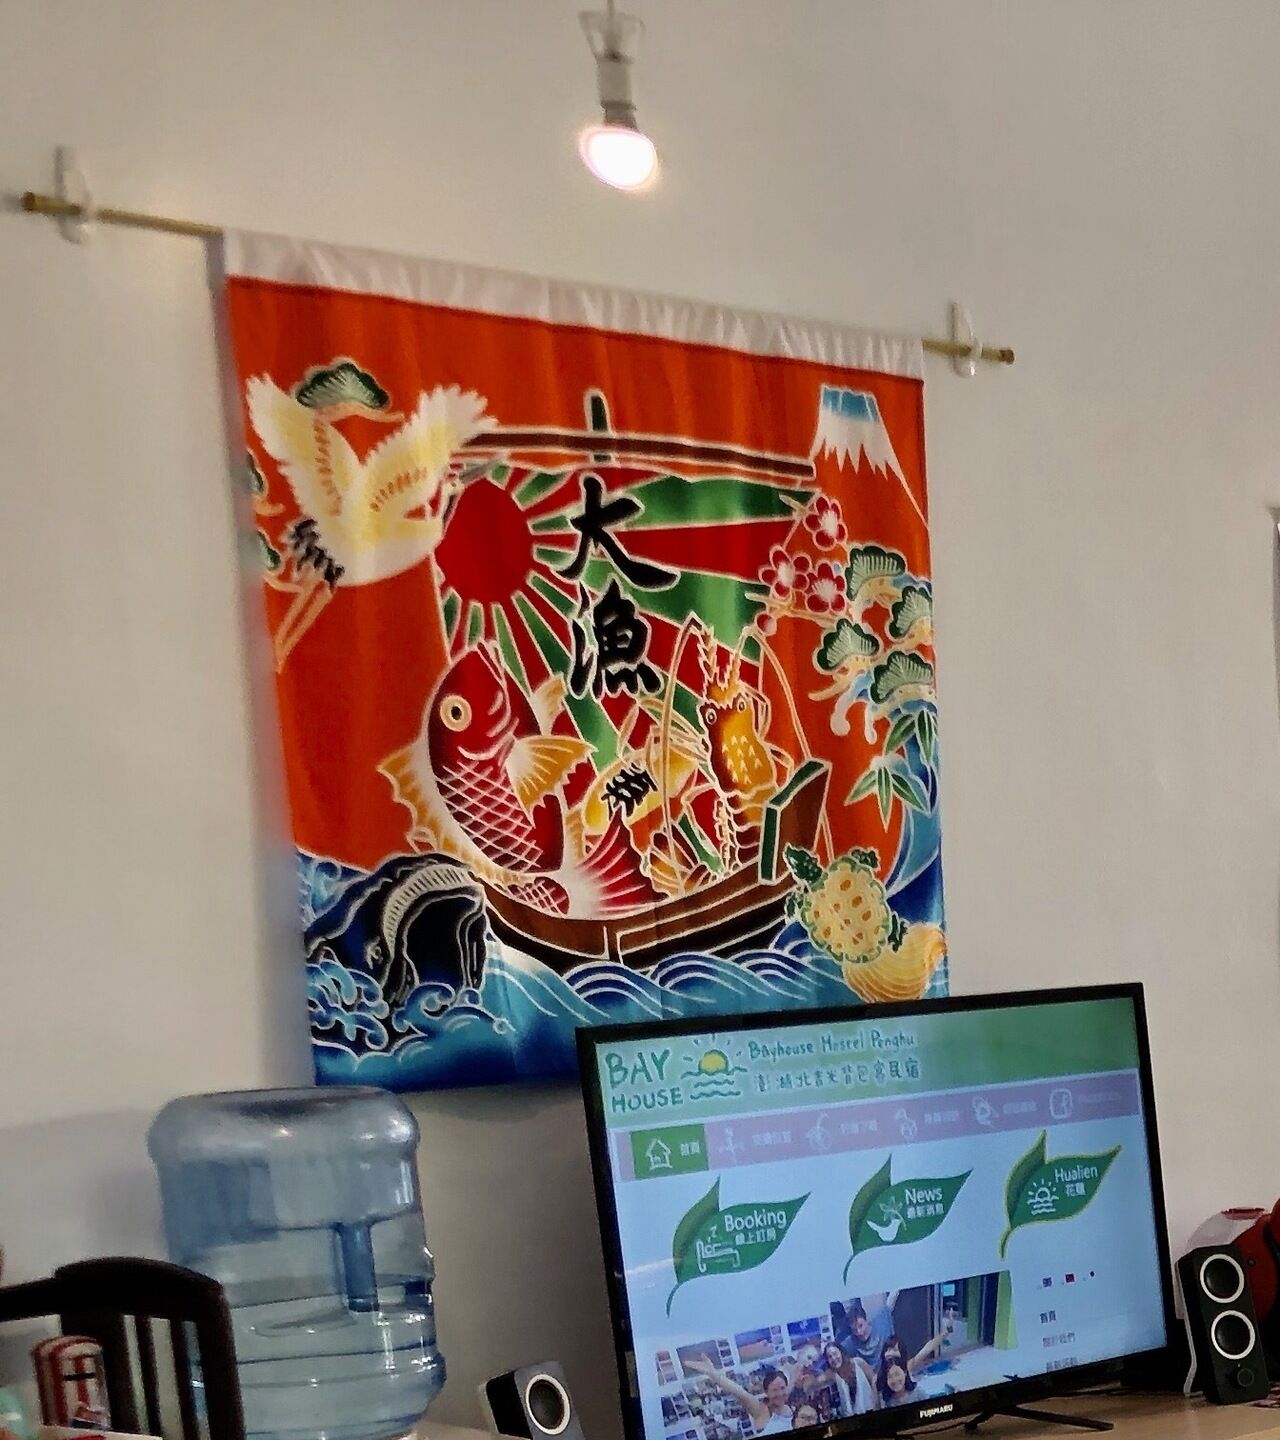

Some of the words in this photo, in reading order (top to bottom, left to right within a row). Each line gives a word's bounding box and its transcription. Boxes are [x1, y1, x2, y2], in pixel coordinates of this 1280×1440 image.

[557, 476, 678, 697] 大漁
[748, 1041, 813, 1062] Bayhouse
[871, 1029, 915, 1048] Penghu
[605, 1050, 670, 1088] BAY
[612, 1087, 683, 1113] HOUSE
[1055, 1165, 1098, 1183] Hualien
[905, 1188, 943, 1205] News
[725, 1208, 787, 1232] Booking
